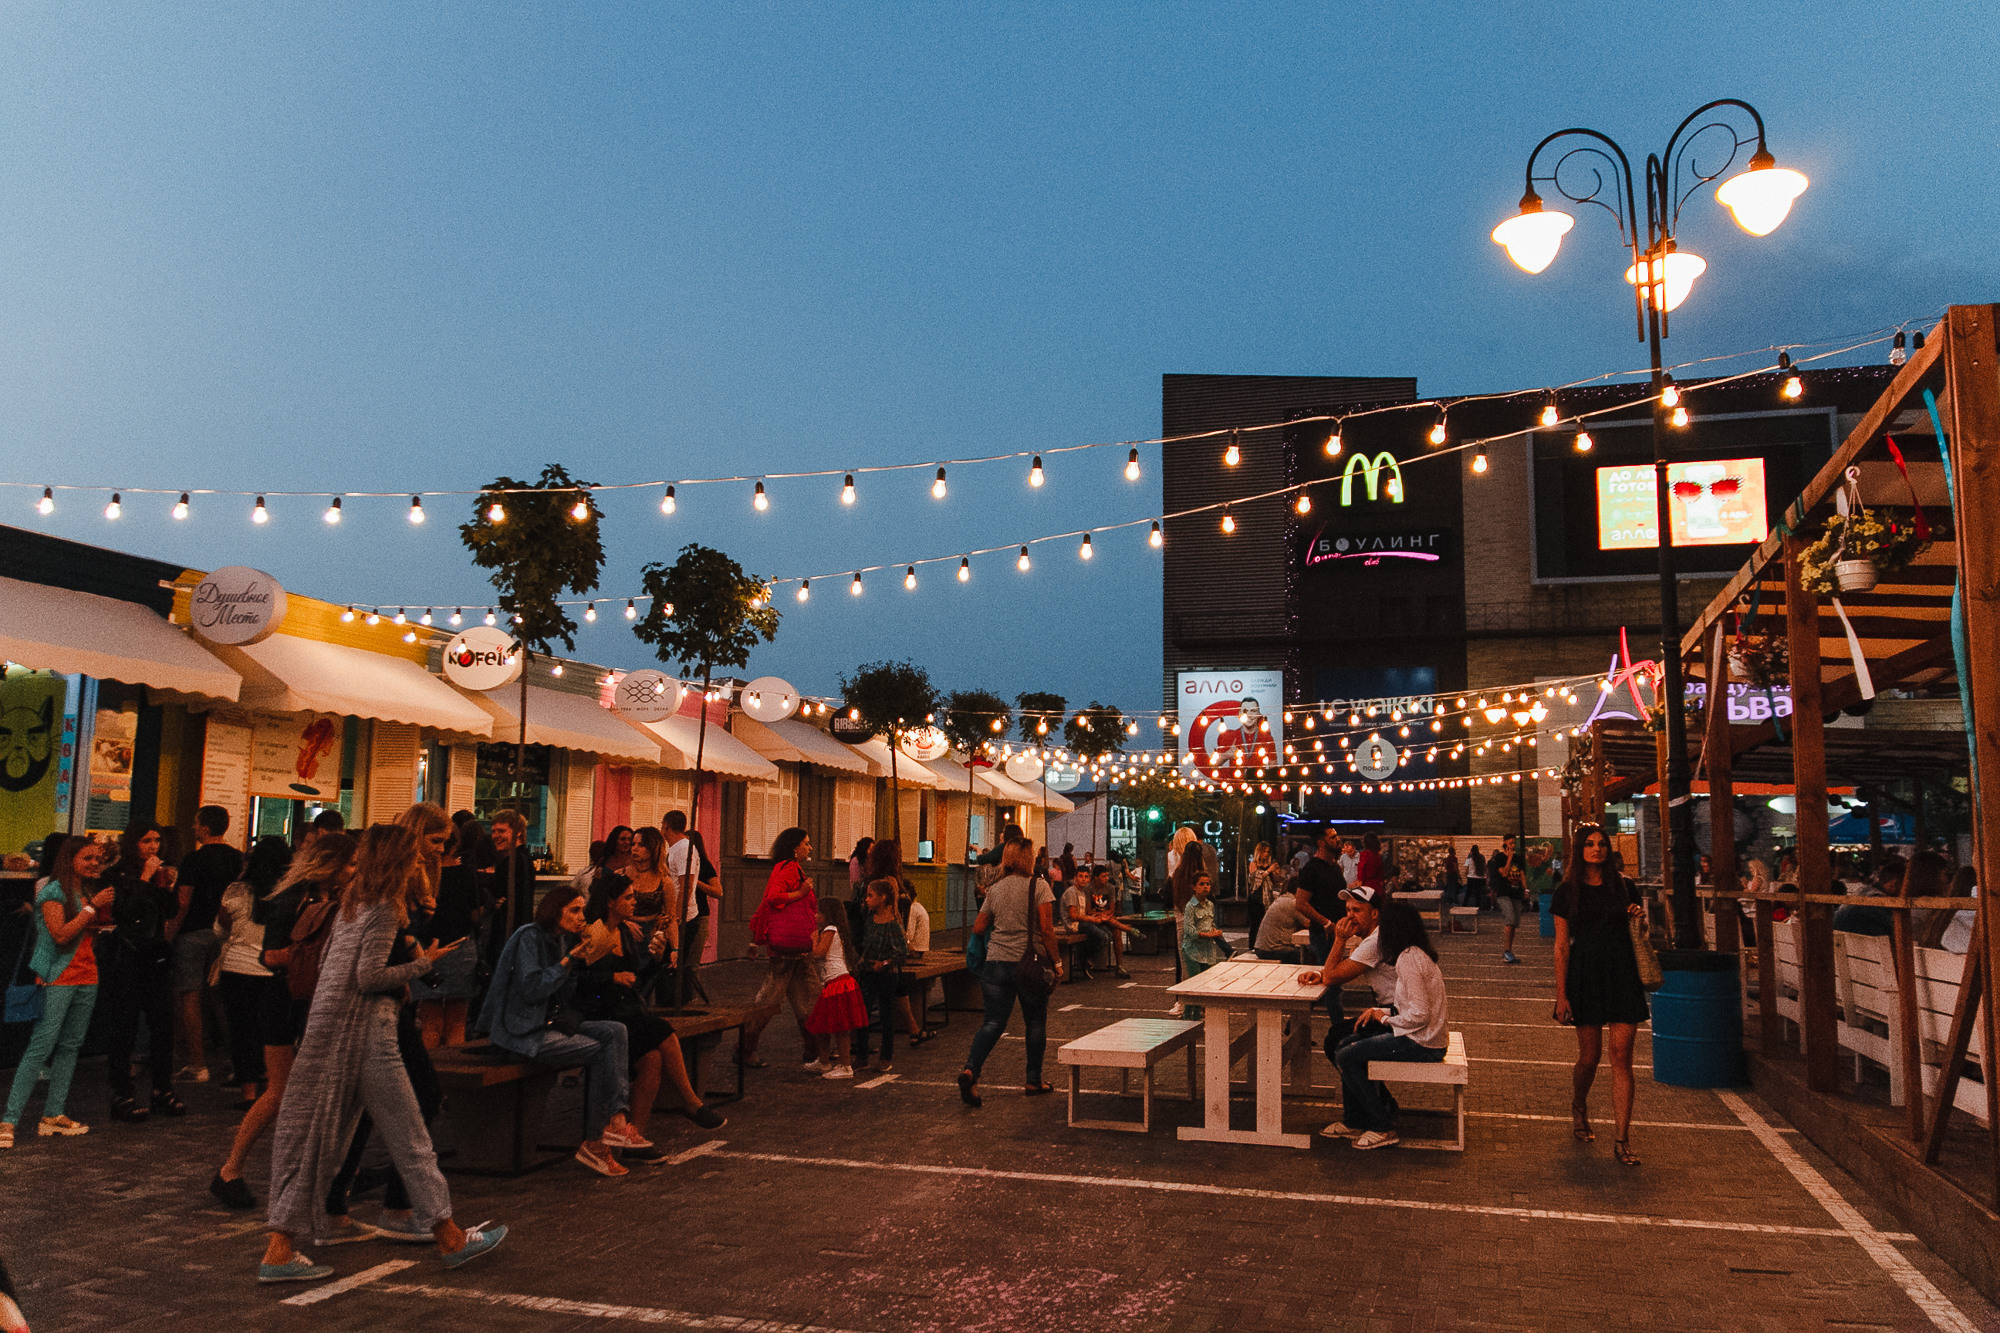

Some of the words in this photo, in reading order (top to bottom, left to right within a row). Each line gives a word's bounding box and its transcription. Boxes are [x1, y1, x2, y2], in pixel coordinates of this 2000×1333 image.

[196, 581, 270, 604] Душевное
[200, 602, 261, 627] Место
[1185, 679, 1244, 694] алло
